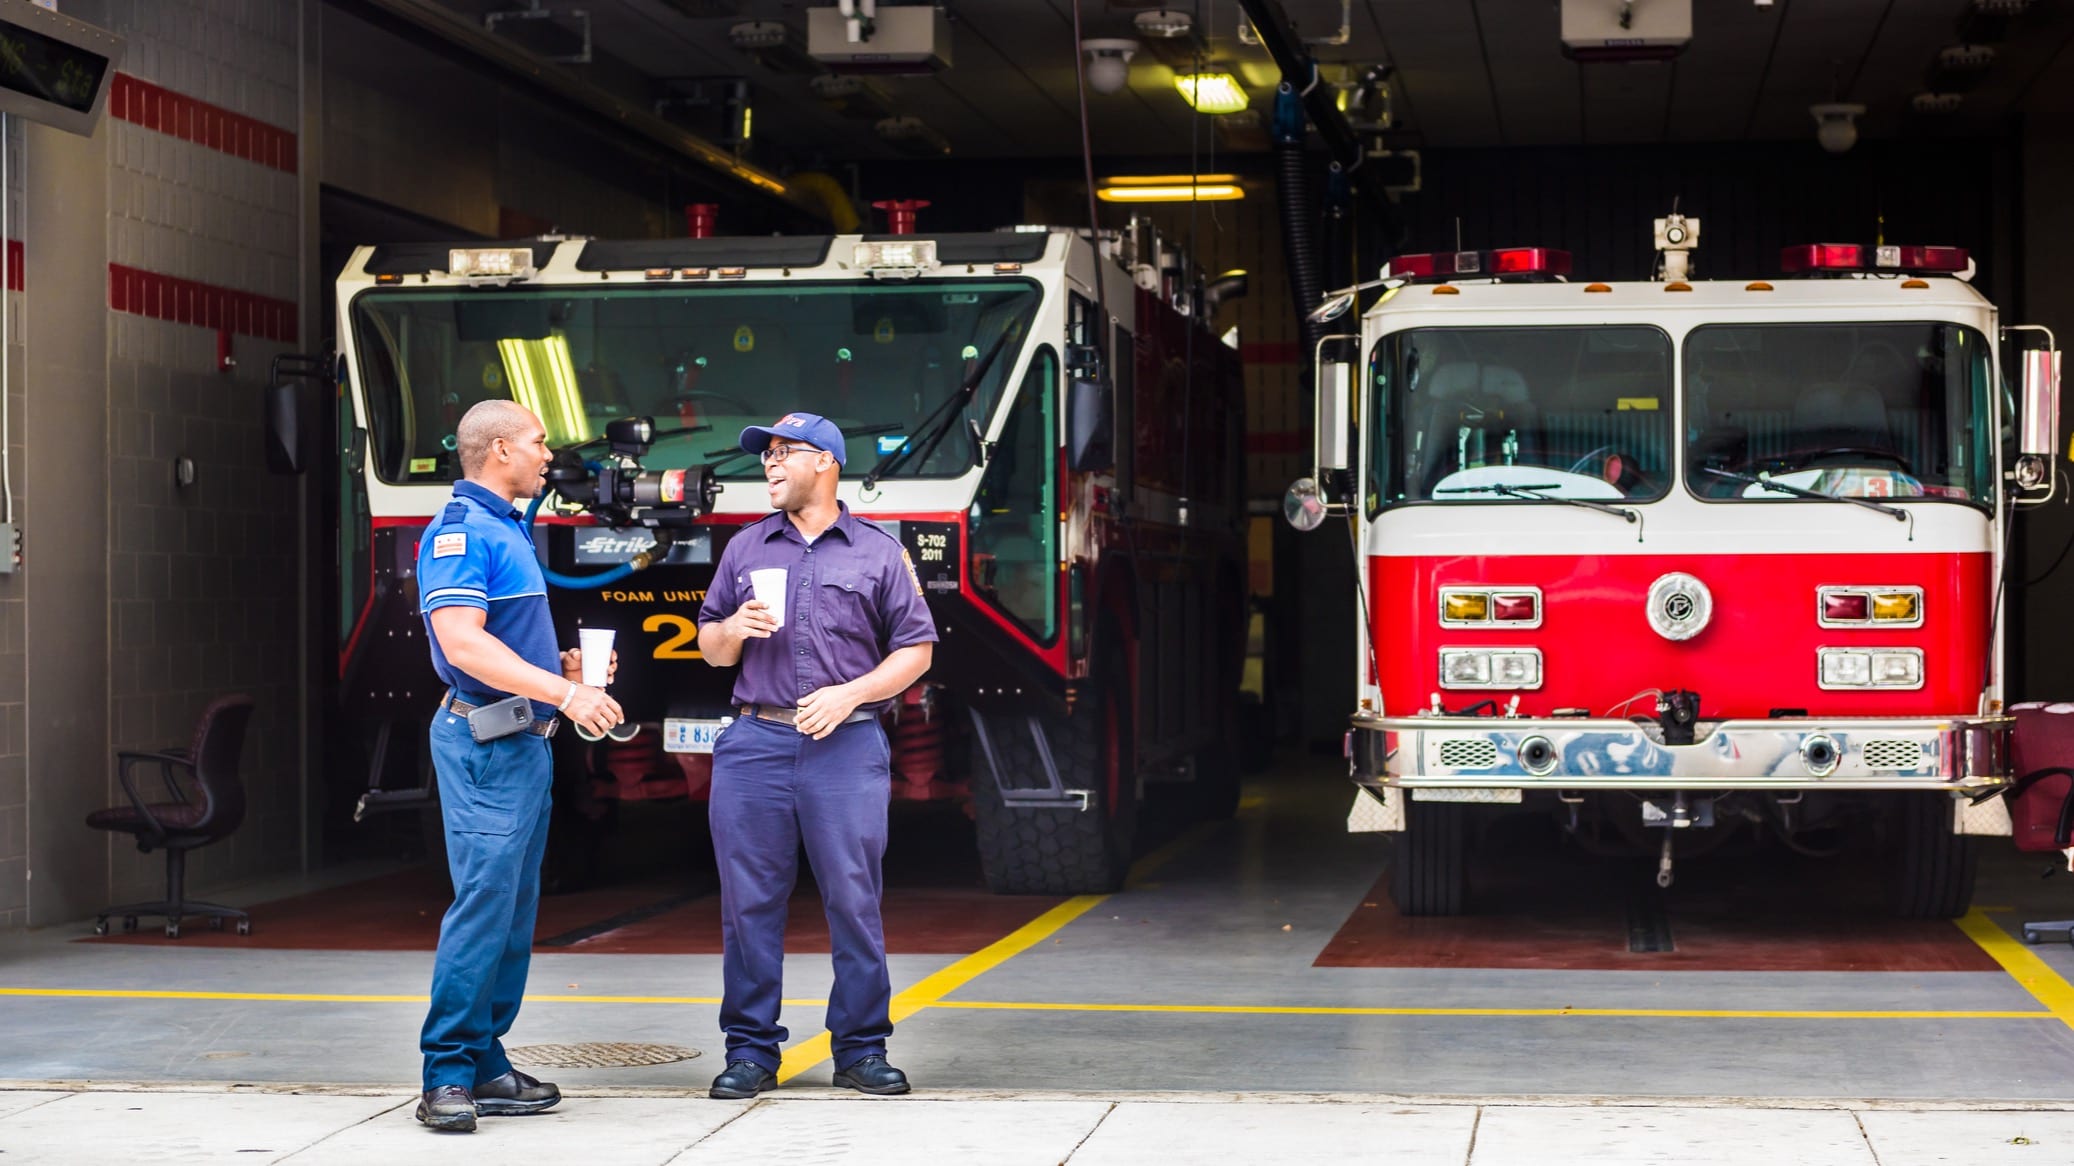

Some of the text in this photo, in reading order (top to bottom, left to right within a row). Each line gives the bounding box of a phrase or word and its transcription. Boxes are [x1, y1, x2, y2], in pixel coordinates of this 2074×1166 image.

[1868, 477, 1888, 497] 3
[579, 536, 658, 553] Strik
[917, 533, 947, 547] S-702
[921, 548, 943, 561] 2011
[601, 590, 708, 602] FOAM UNIT
[642, 614, 706, 659] 2
